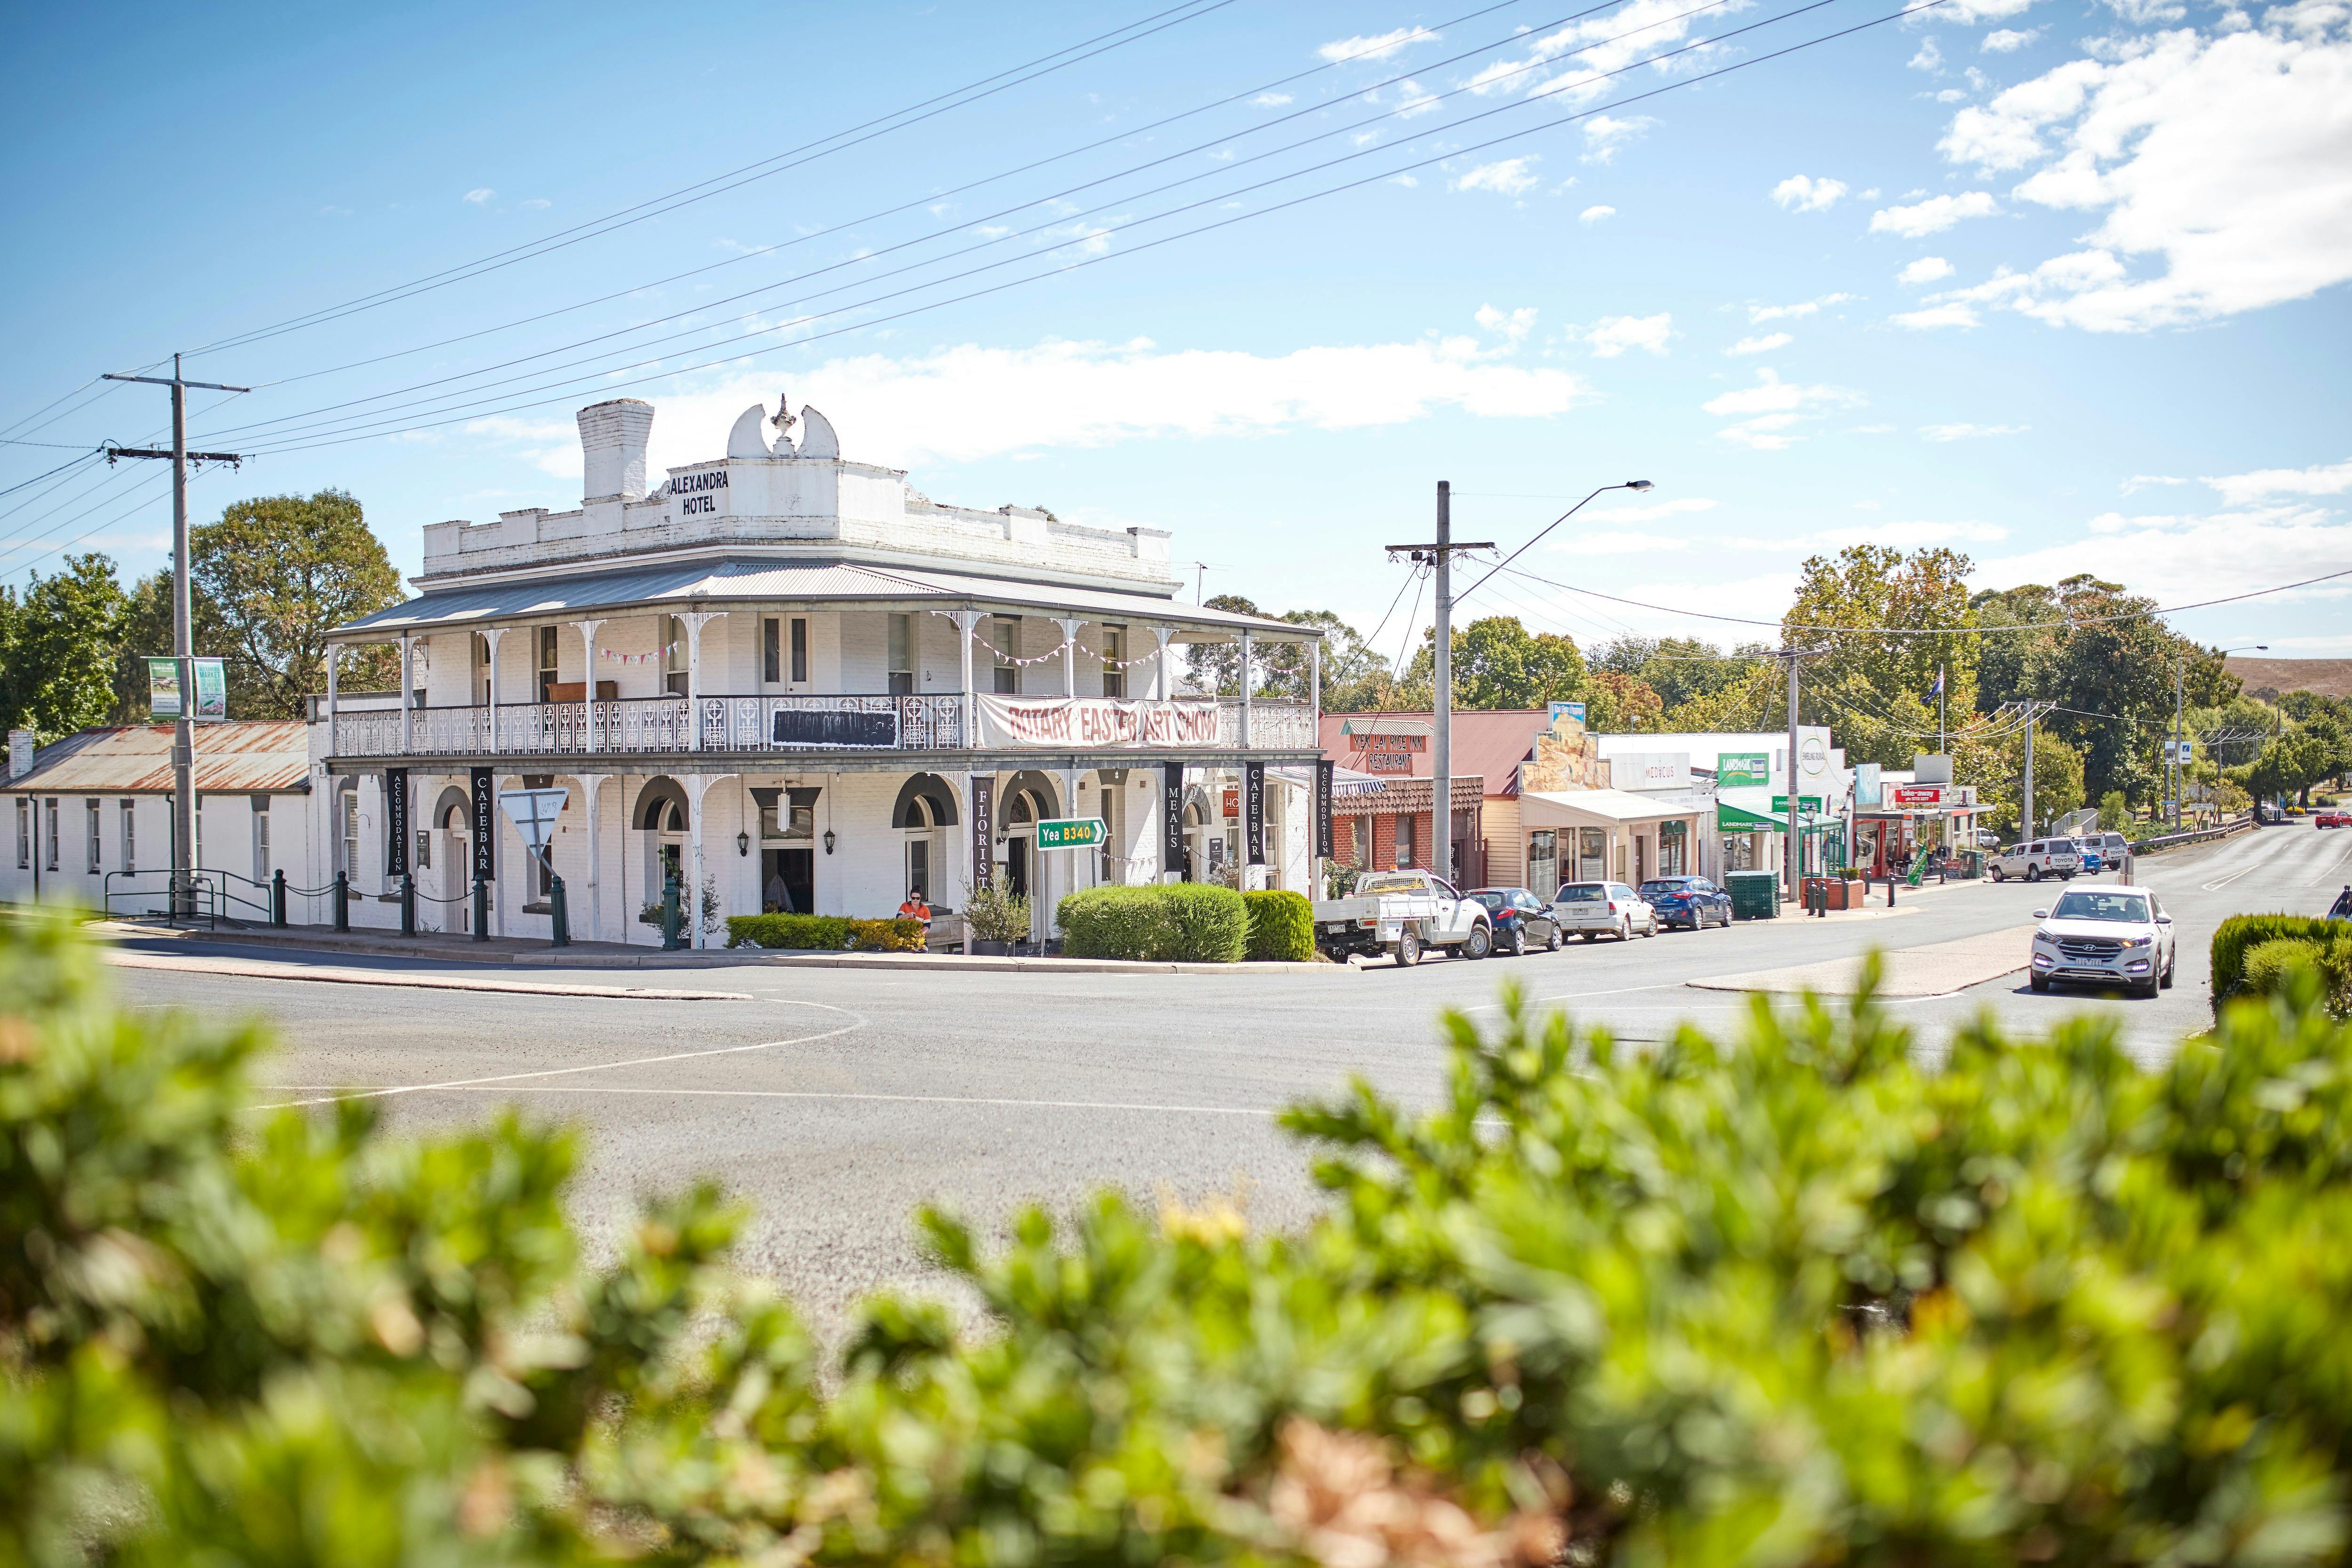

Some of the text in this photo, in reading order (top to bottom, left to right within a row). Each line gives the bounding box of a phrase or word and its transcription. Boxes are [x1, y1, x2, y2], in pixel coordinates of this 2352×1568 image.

[670, 471, 728, 495] ALEXANDRA
[683, 495, 715, 515] HOTEL
[1009, 706, 1217, 741] ROTARY EASTER ART SHOW
[1353, 734, 1422, 750] YEN LAI RICE INN
[1368, 753, 1411, 771] RESTAURANT
[1723, 758, 1751, 771] LANDMARK
[477, 777, 488, 869] CAFE-BAR
[1168, 788, 1178, 848] MEALS
[1250, 770, 1259, 855] CAFE-BAR
[977, 791, 987, 889] FLORIST
[1042, 826, 1090, 841] Yea B340
